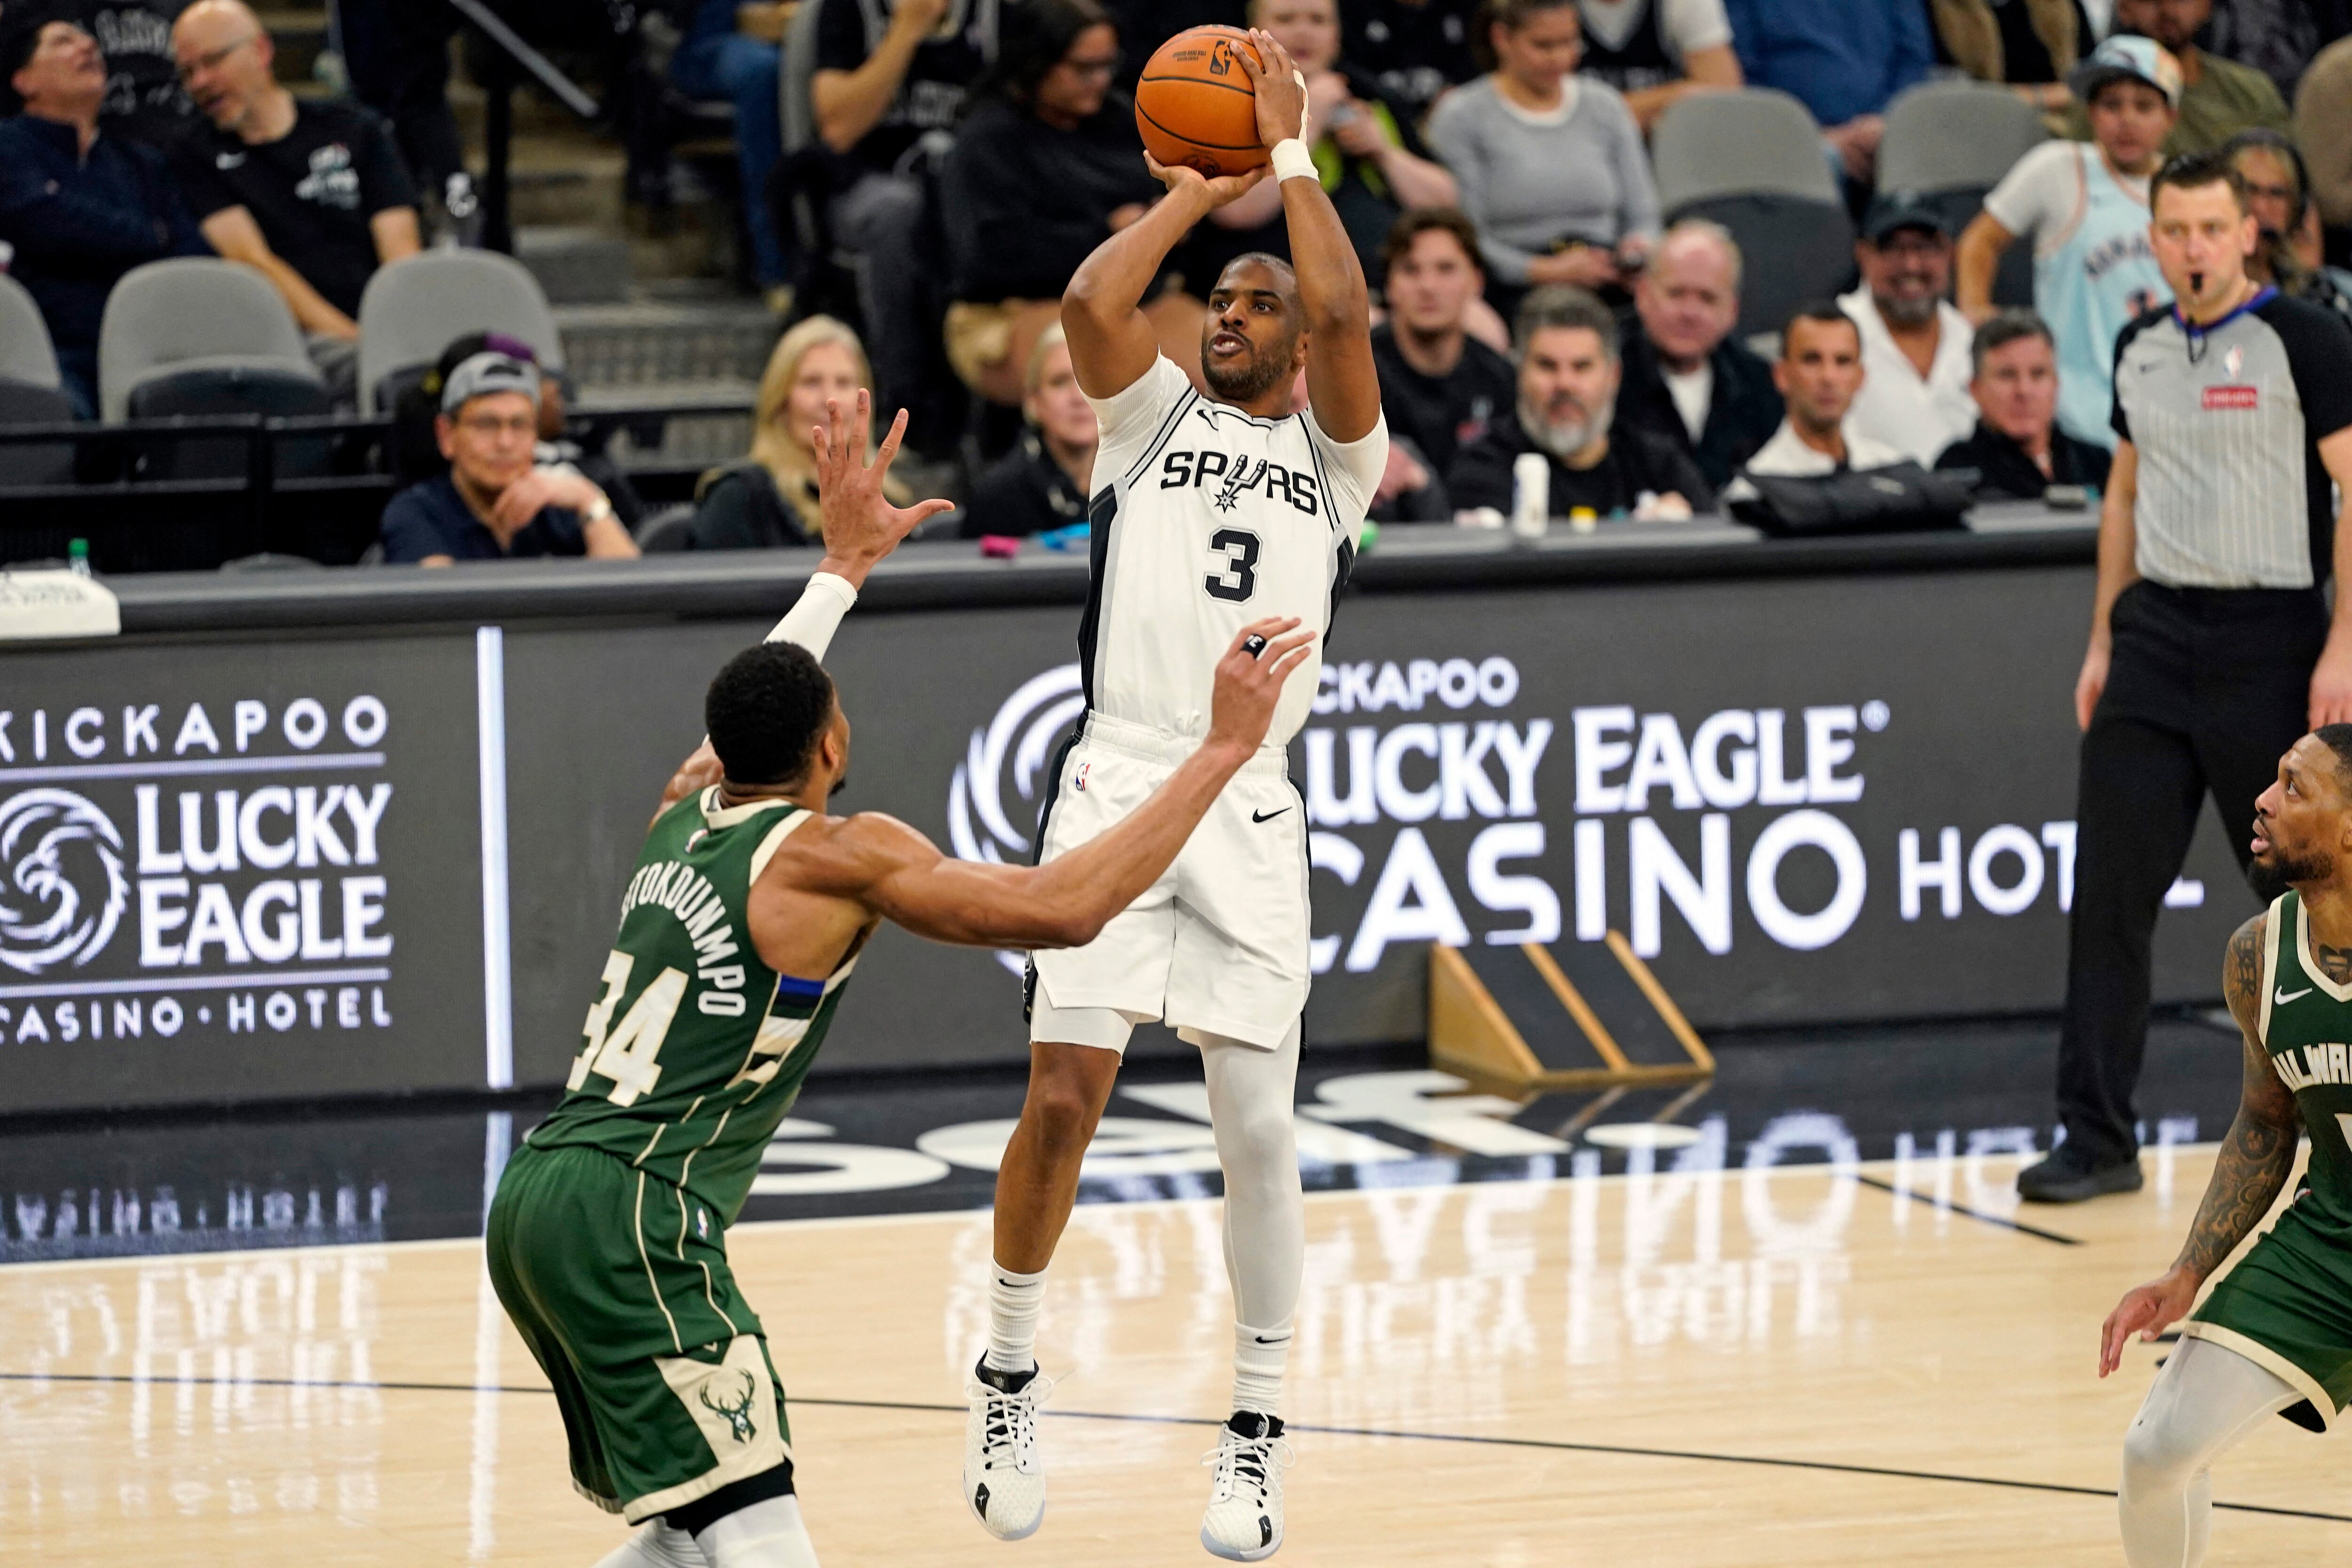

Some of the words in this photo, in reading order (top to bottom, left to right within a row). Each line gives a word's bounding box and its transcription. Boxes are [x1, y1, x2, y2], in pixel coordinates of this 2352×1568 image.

[1160, 451, 1317, 516] SPURS
[1201, 525, 1264, 605] 3
[1303, 718, 1553, 828] UCKY
[135, 783, 393, 874] LUCKY
[138, 876, 394, 967] EAGLE
[228, 987, 392, 1033] HOTEL
[566, 949, 689, 1108] 34
[2272, 1042, 2352, 1094] ILWA
